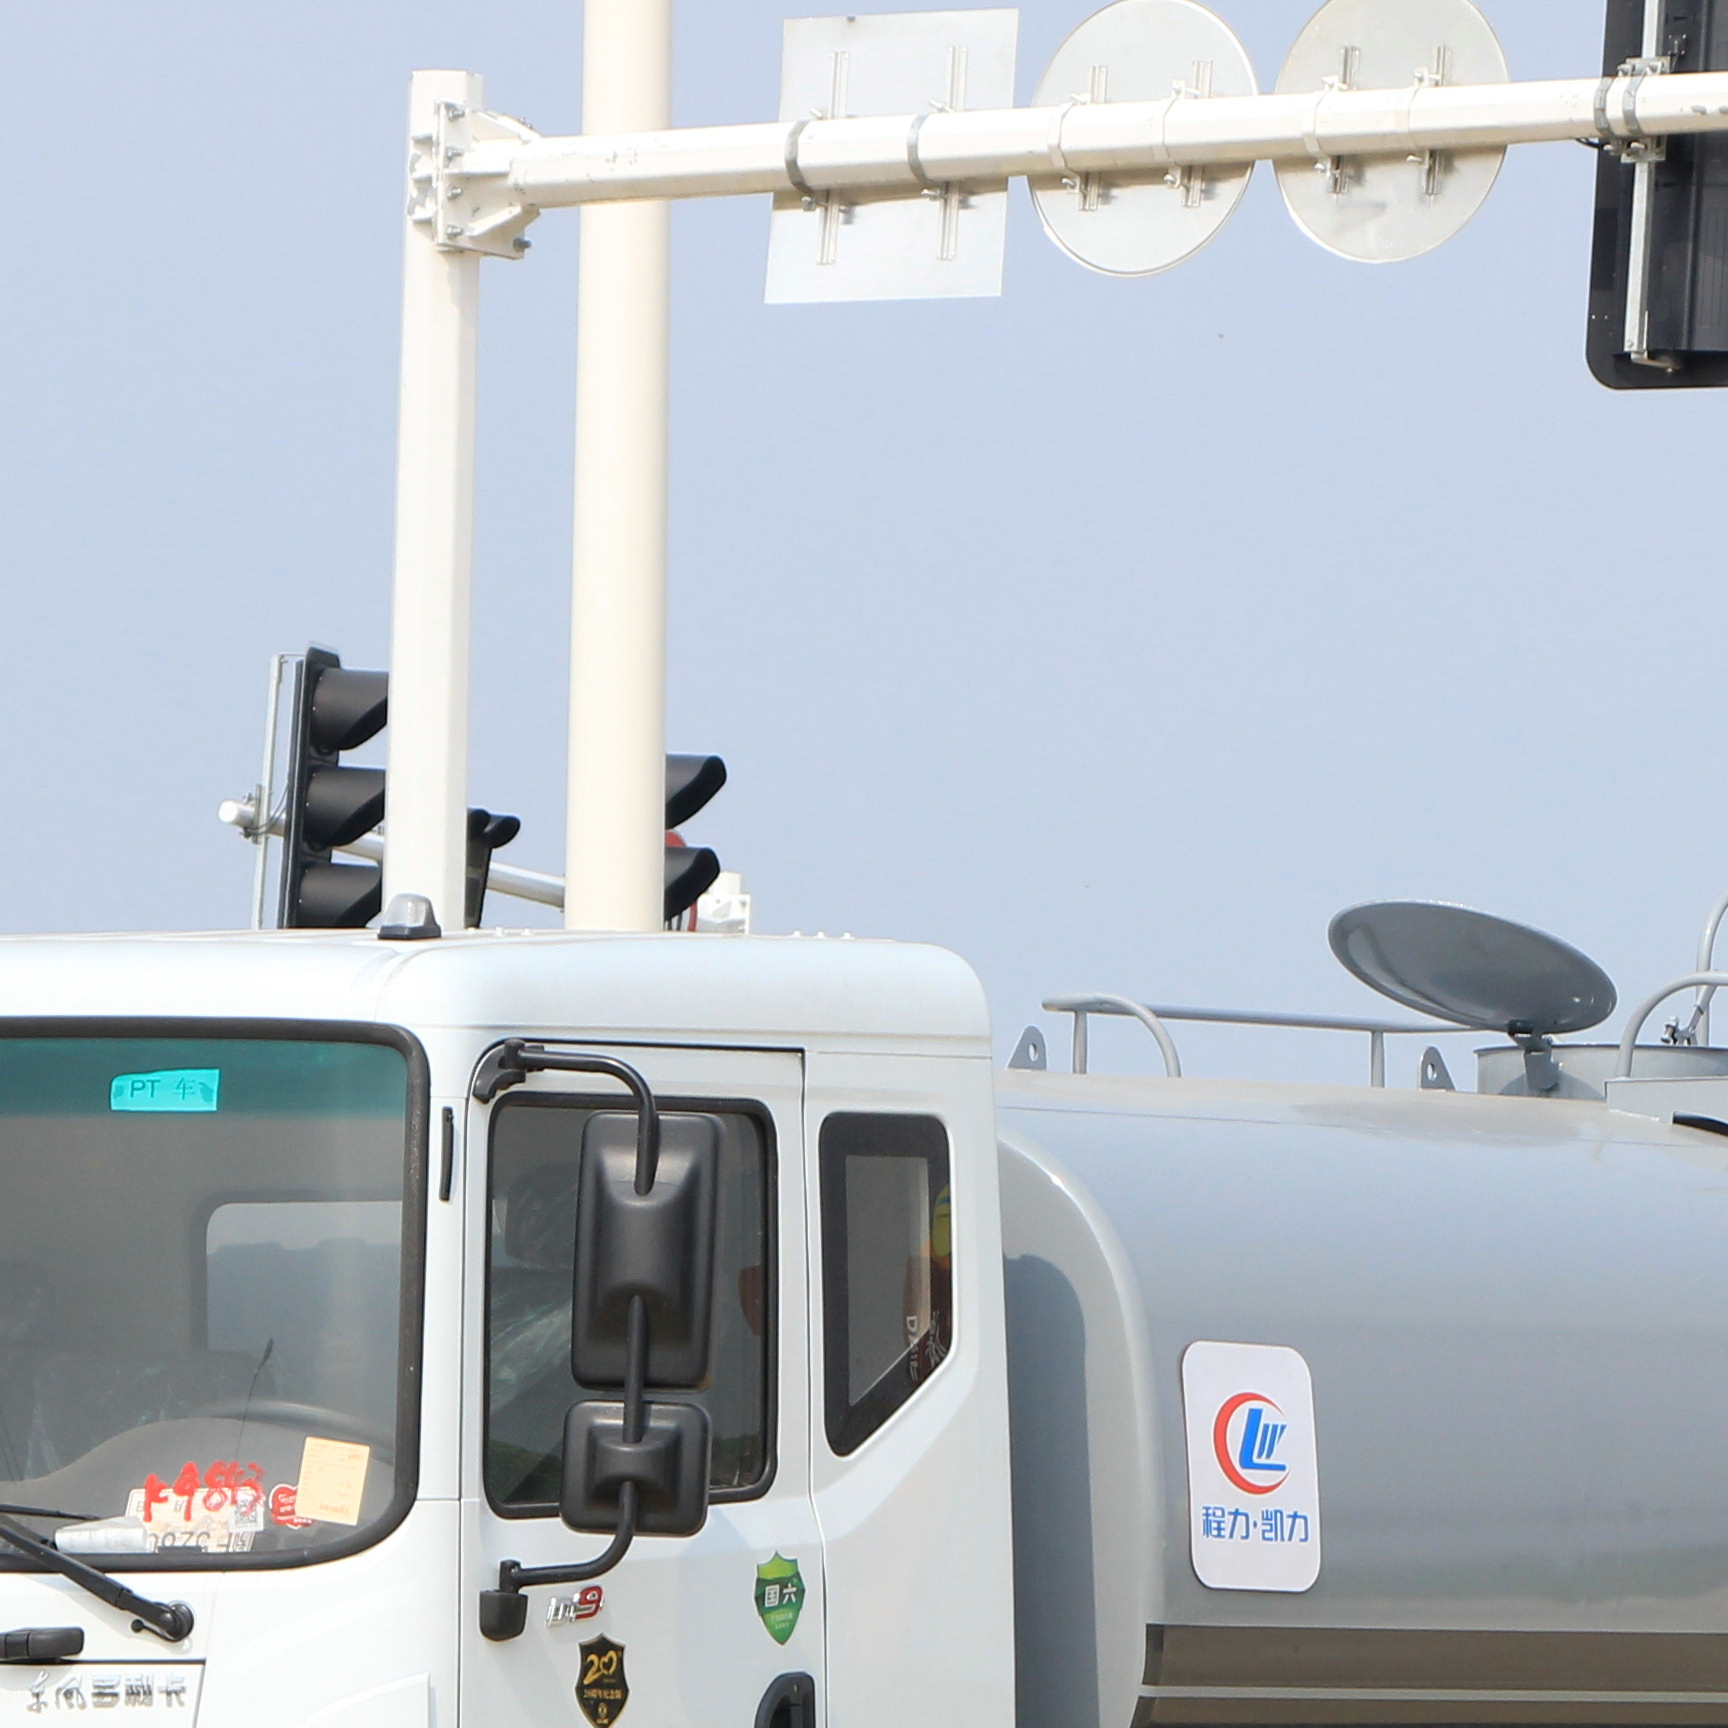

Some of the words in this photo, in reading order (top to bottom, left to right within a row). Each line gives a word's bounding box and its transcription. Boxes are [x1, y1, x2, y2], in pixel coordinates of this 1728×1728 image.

[130, 1079, 161, 1098] PT
[1202, 1505, 1309, 1543] 程力·凯力
[764, 1582, 797, 1608] 国六
